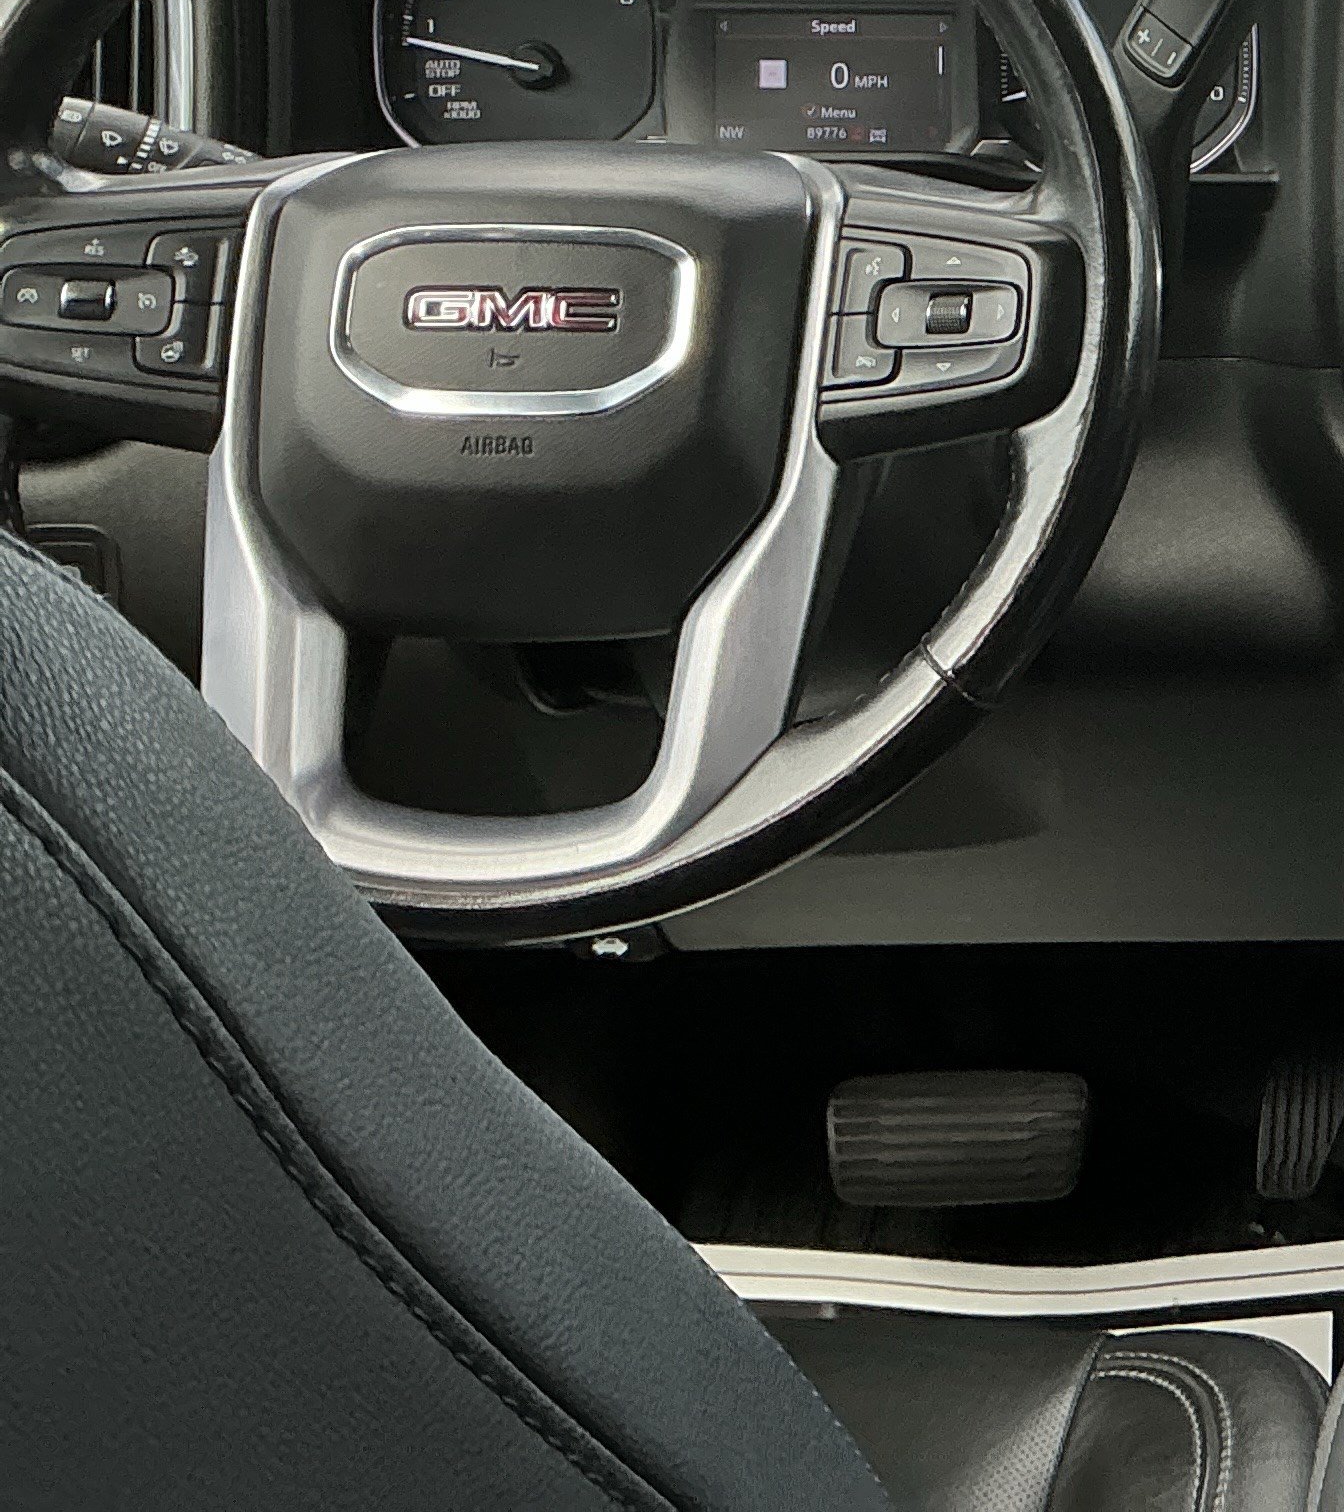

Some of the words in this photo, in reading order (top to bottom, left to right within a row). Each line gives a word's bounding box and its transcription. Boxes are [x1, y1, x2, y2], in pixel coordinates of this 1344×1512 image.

[426, 19, 435, 33] 1
[811, 20, 856, 35] Speed
[830, 62, 849, 88] 0
[855, 75, 889, 88] MPH
[428, 84, 461, 97] OFF
[821, 107, 856, 119] Menu
[720, 126, 744, 139] NW
[807, 127, 847, 139] 89776
[403, 285, 623, 332] GMC
[459, 437, 534, 456] AIRBAG
